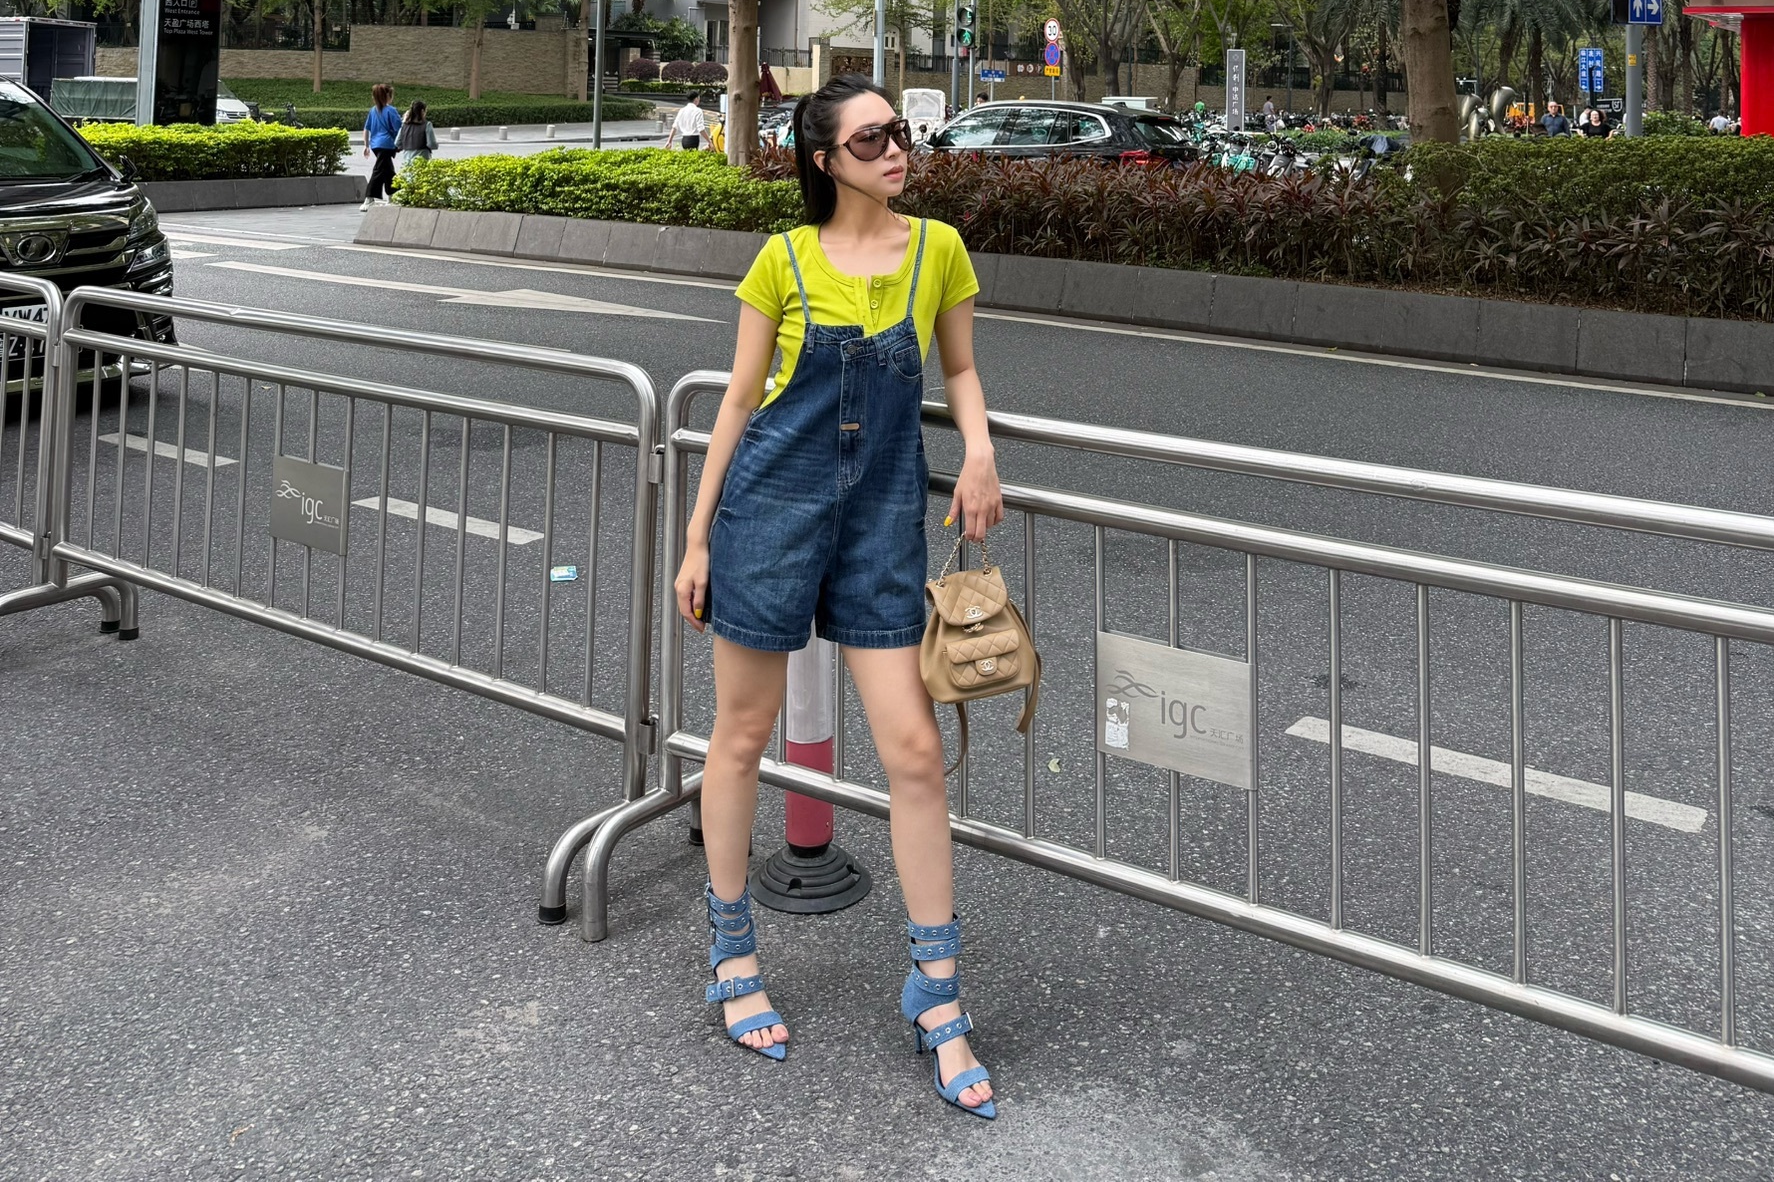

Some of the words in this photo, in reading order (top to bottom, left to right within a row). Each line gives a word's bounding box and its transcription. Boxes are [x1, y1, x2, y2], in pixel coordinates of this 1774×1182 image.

[164, 18, 210, 29] 天盈广场西塔
[1048, 25, 1057, 36] 30
[301, 491, 324, 524] igc
[1161, 690, 1207, 740] igc
[1210, 727, 1244, 745] 天汇广场
